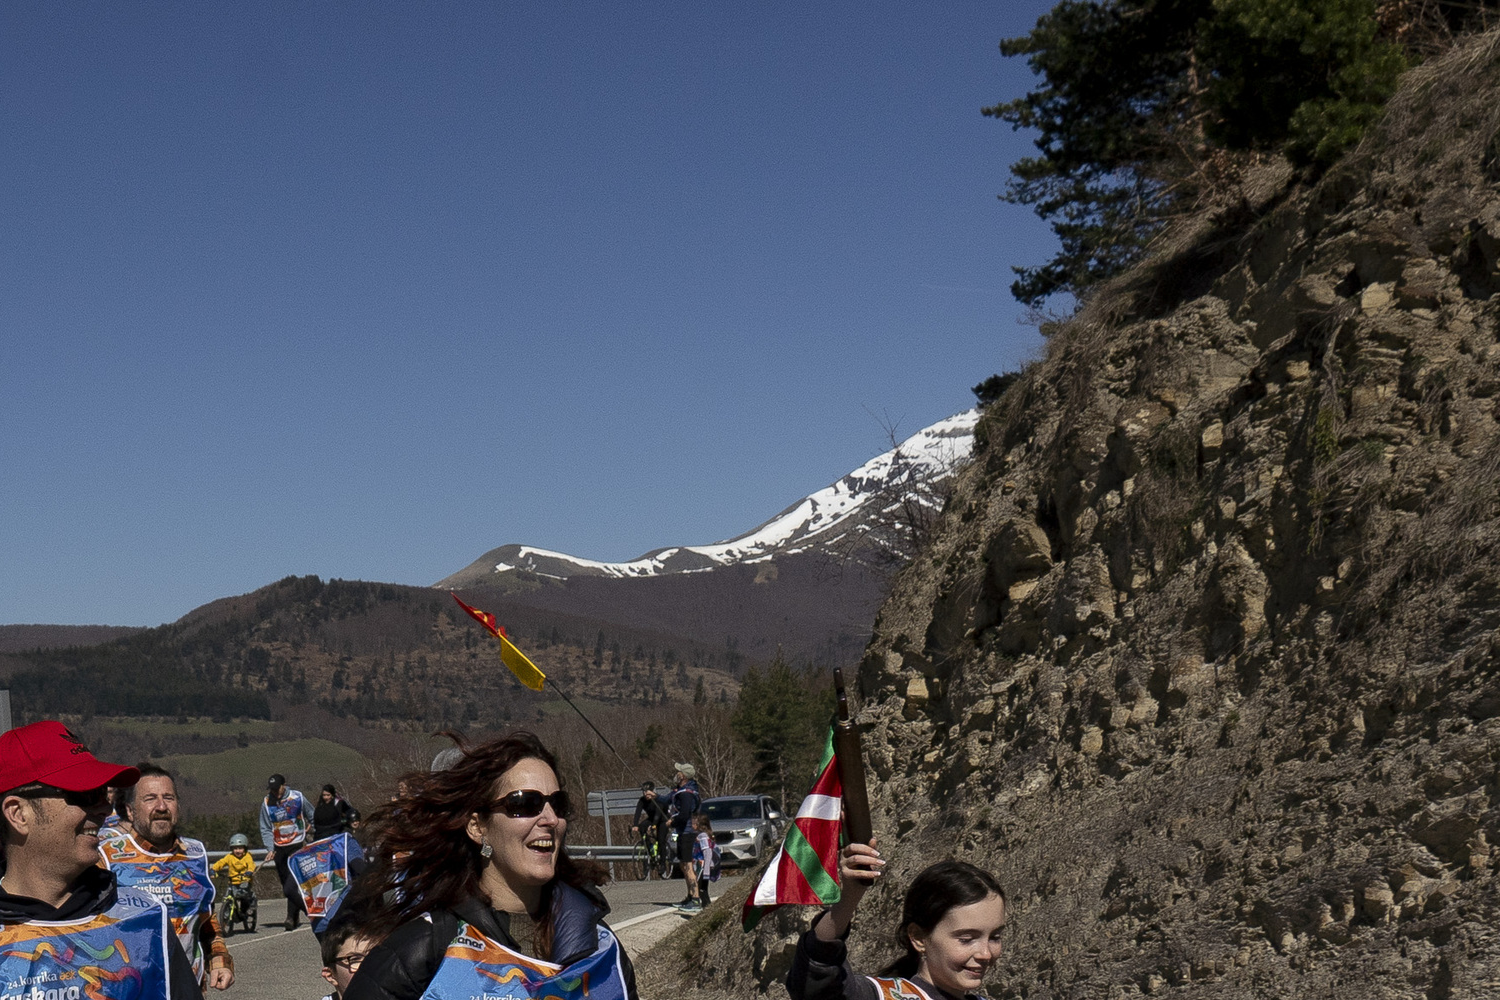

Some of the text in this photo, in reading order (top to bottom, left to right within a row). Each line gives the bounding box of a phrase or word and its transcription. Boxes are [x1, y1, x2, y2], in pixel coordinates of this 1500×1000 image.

[117, 894, 150, 908] eitb
[158, 894, 174, 905] ra
[7, 969, 76, 990] 24.korrika aek
